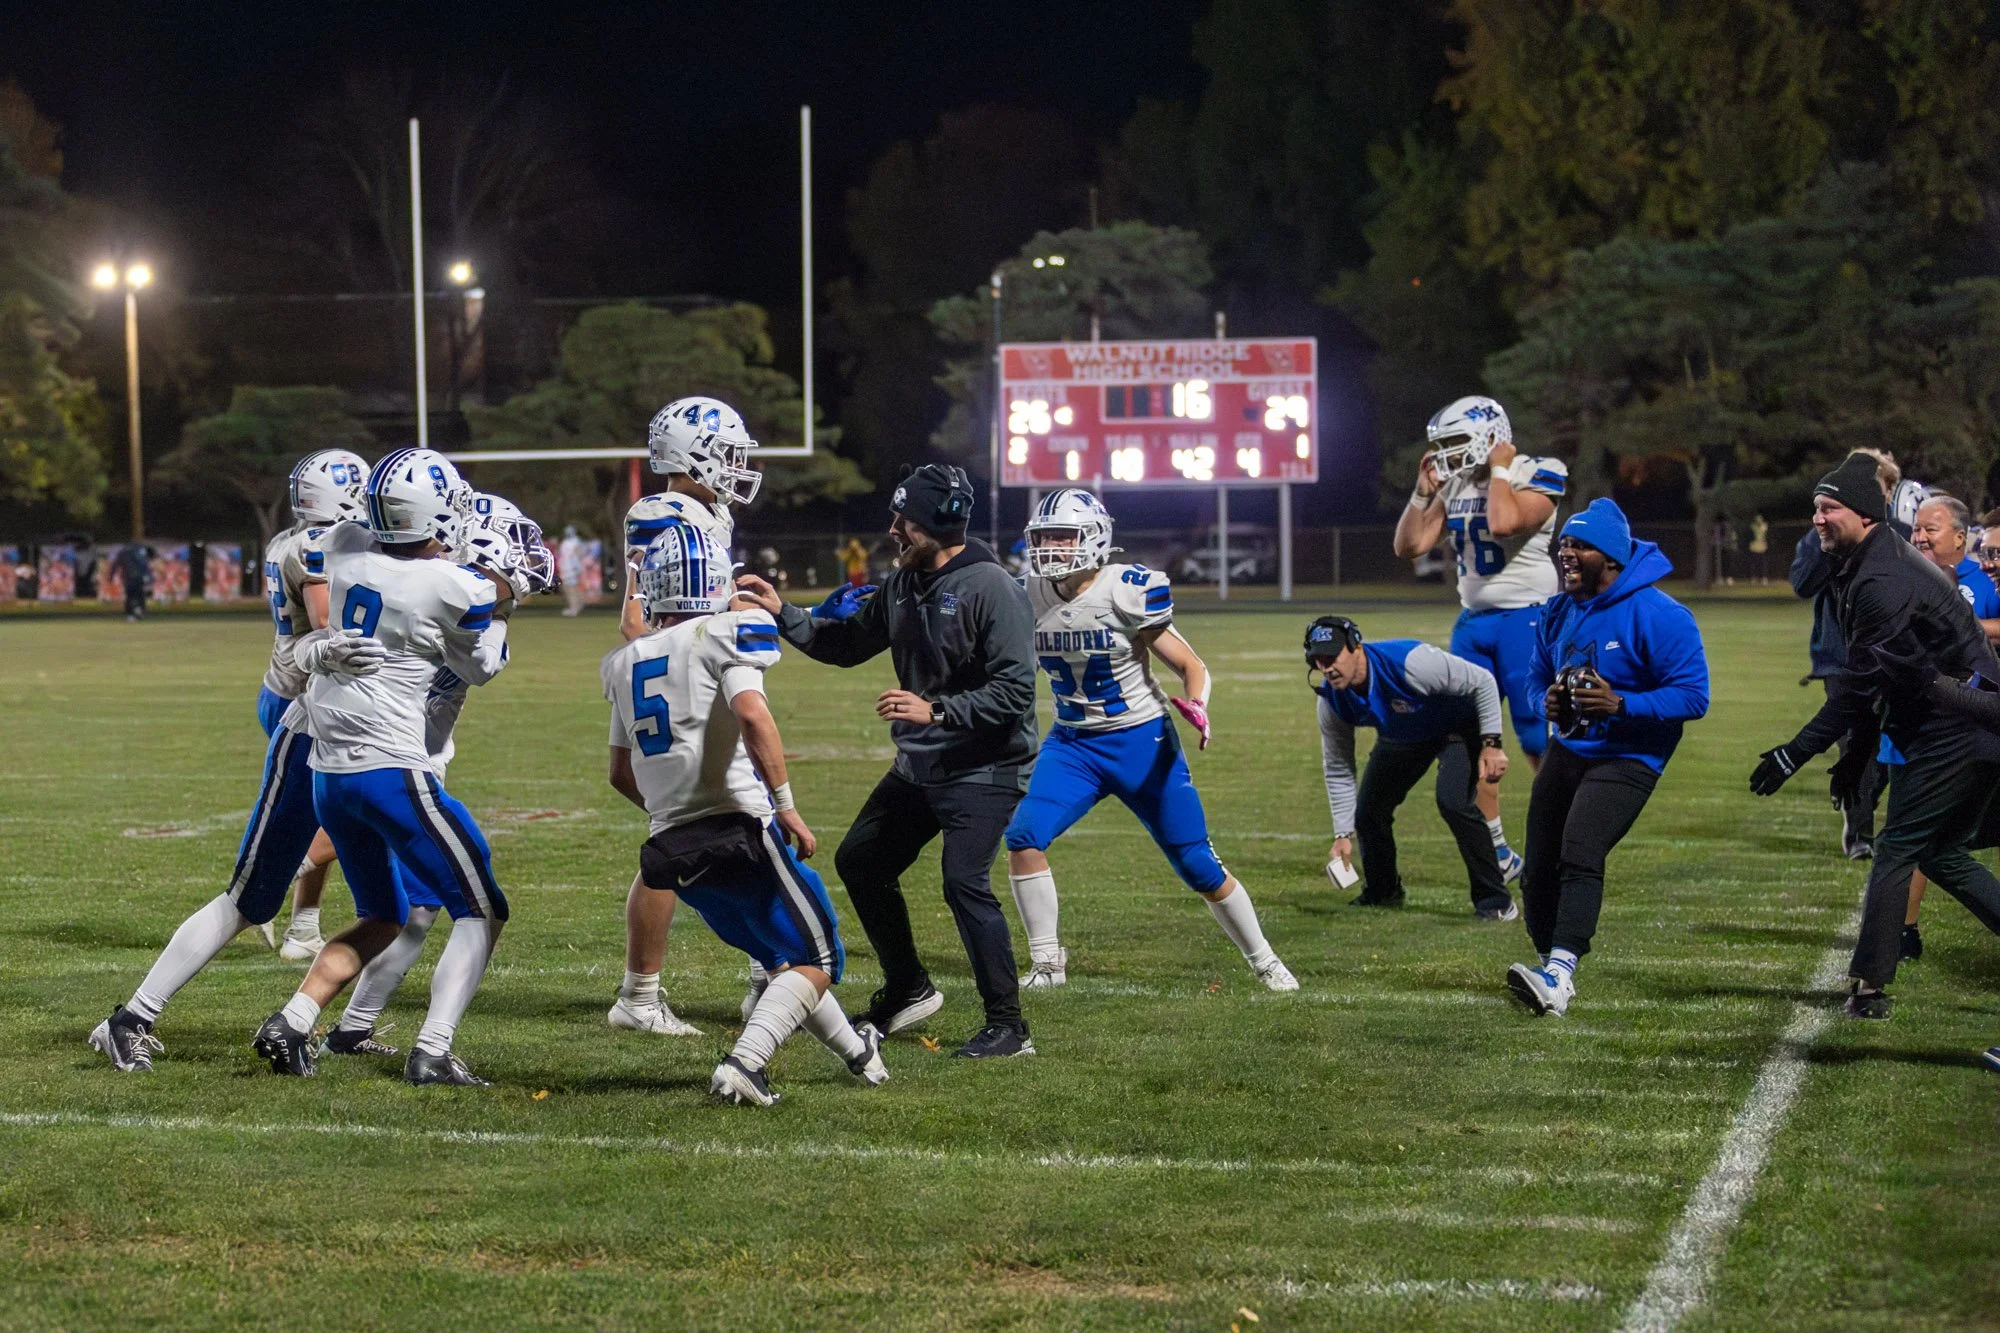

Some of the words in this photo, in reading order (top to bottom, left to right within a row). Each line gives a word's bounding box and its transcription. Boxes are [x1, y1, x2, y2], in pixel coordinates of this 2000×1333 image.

[1065, 344, 1167, 363] WALNUT
[1072, 363, 1133, 379] HIGH
[1139, 362, 1240, 378] SCHOOL
[1173, 379, 1211, 419] 16
[683, 404, 720, 432] 44
[428, 464, 448, 492] 9
[1446, 516, 1506, 577] 76
[675, 600, 711, 611] WOLVES
[1035, 627, 1116, 652] ILBOURNE
[1038, 654, 1129, 722] 24
[632, 655, 674, 757] 5
